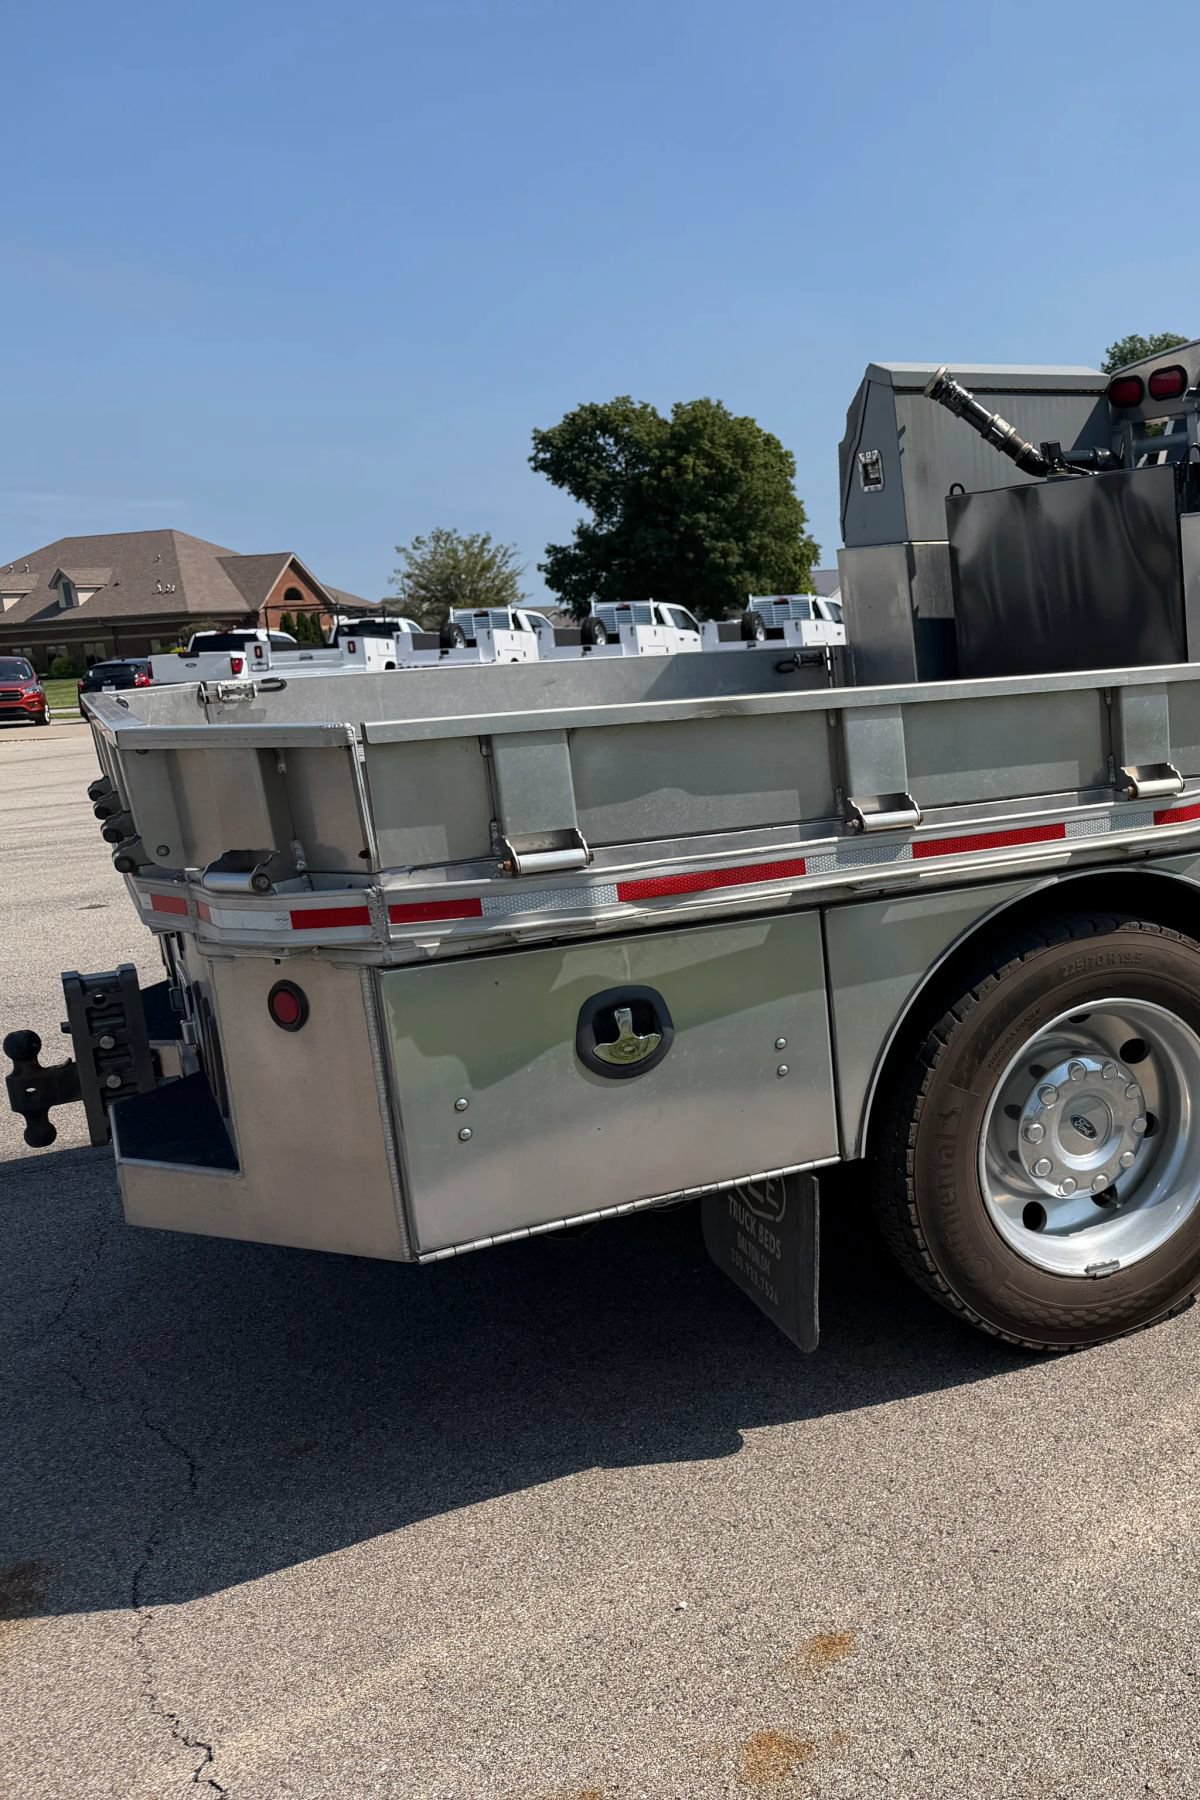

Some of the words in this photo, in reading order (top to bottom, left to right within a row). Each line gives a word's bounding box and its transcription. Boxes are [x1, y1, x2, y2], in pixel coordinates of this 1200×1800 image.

[1074, 1118, 1094, 1135] Ford
[728, 1194, 758, 1238] TRUCK
[758, 1222, 782, 1261] BEDS
[936, 1132, 994, 1288] Continental
